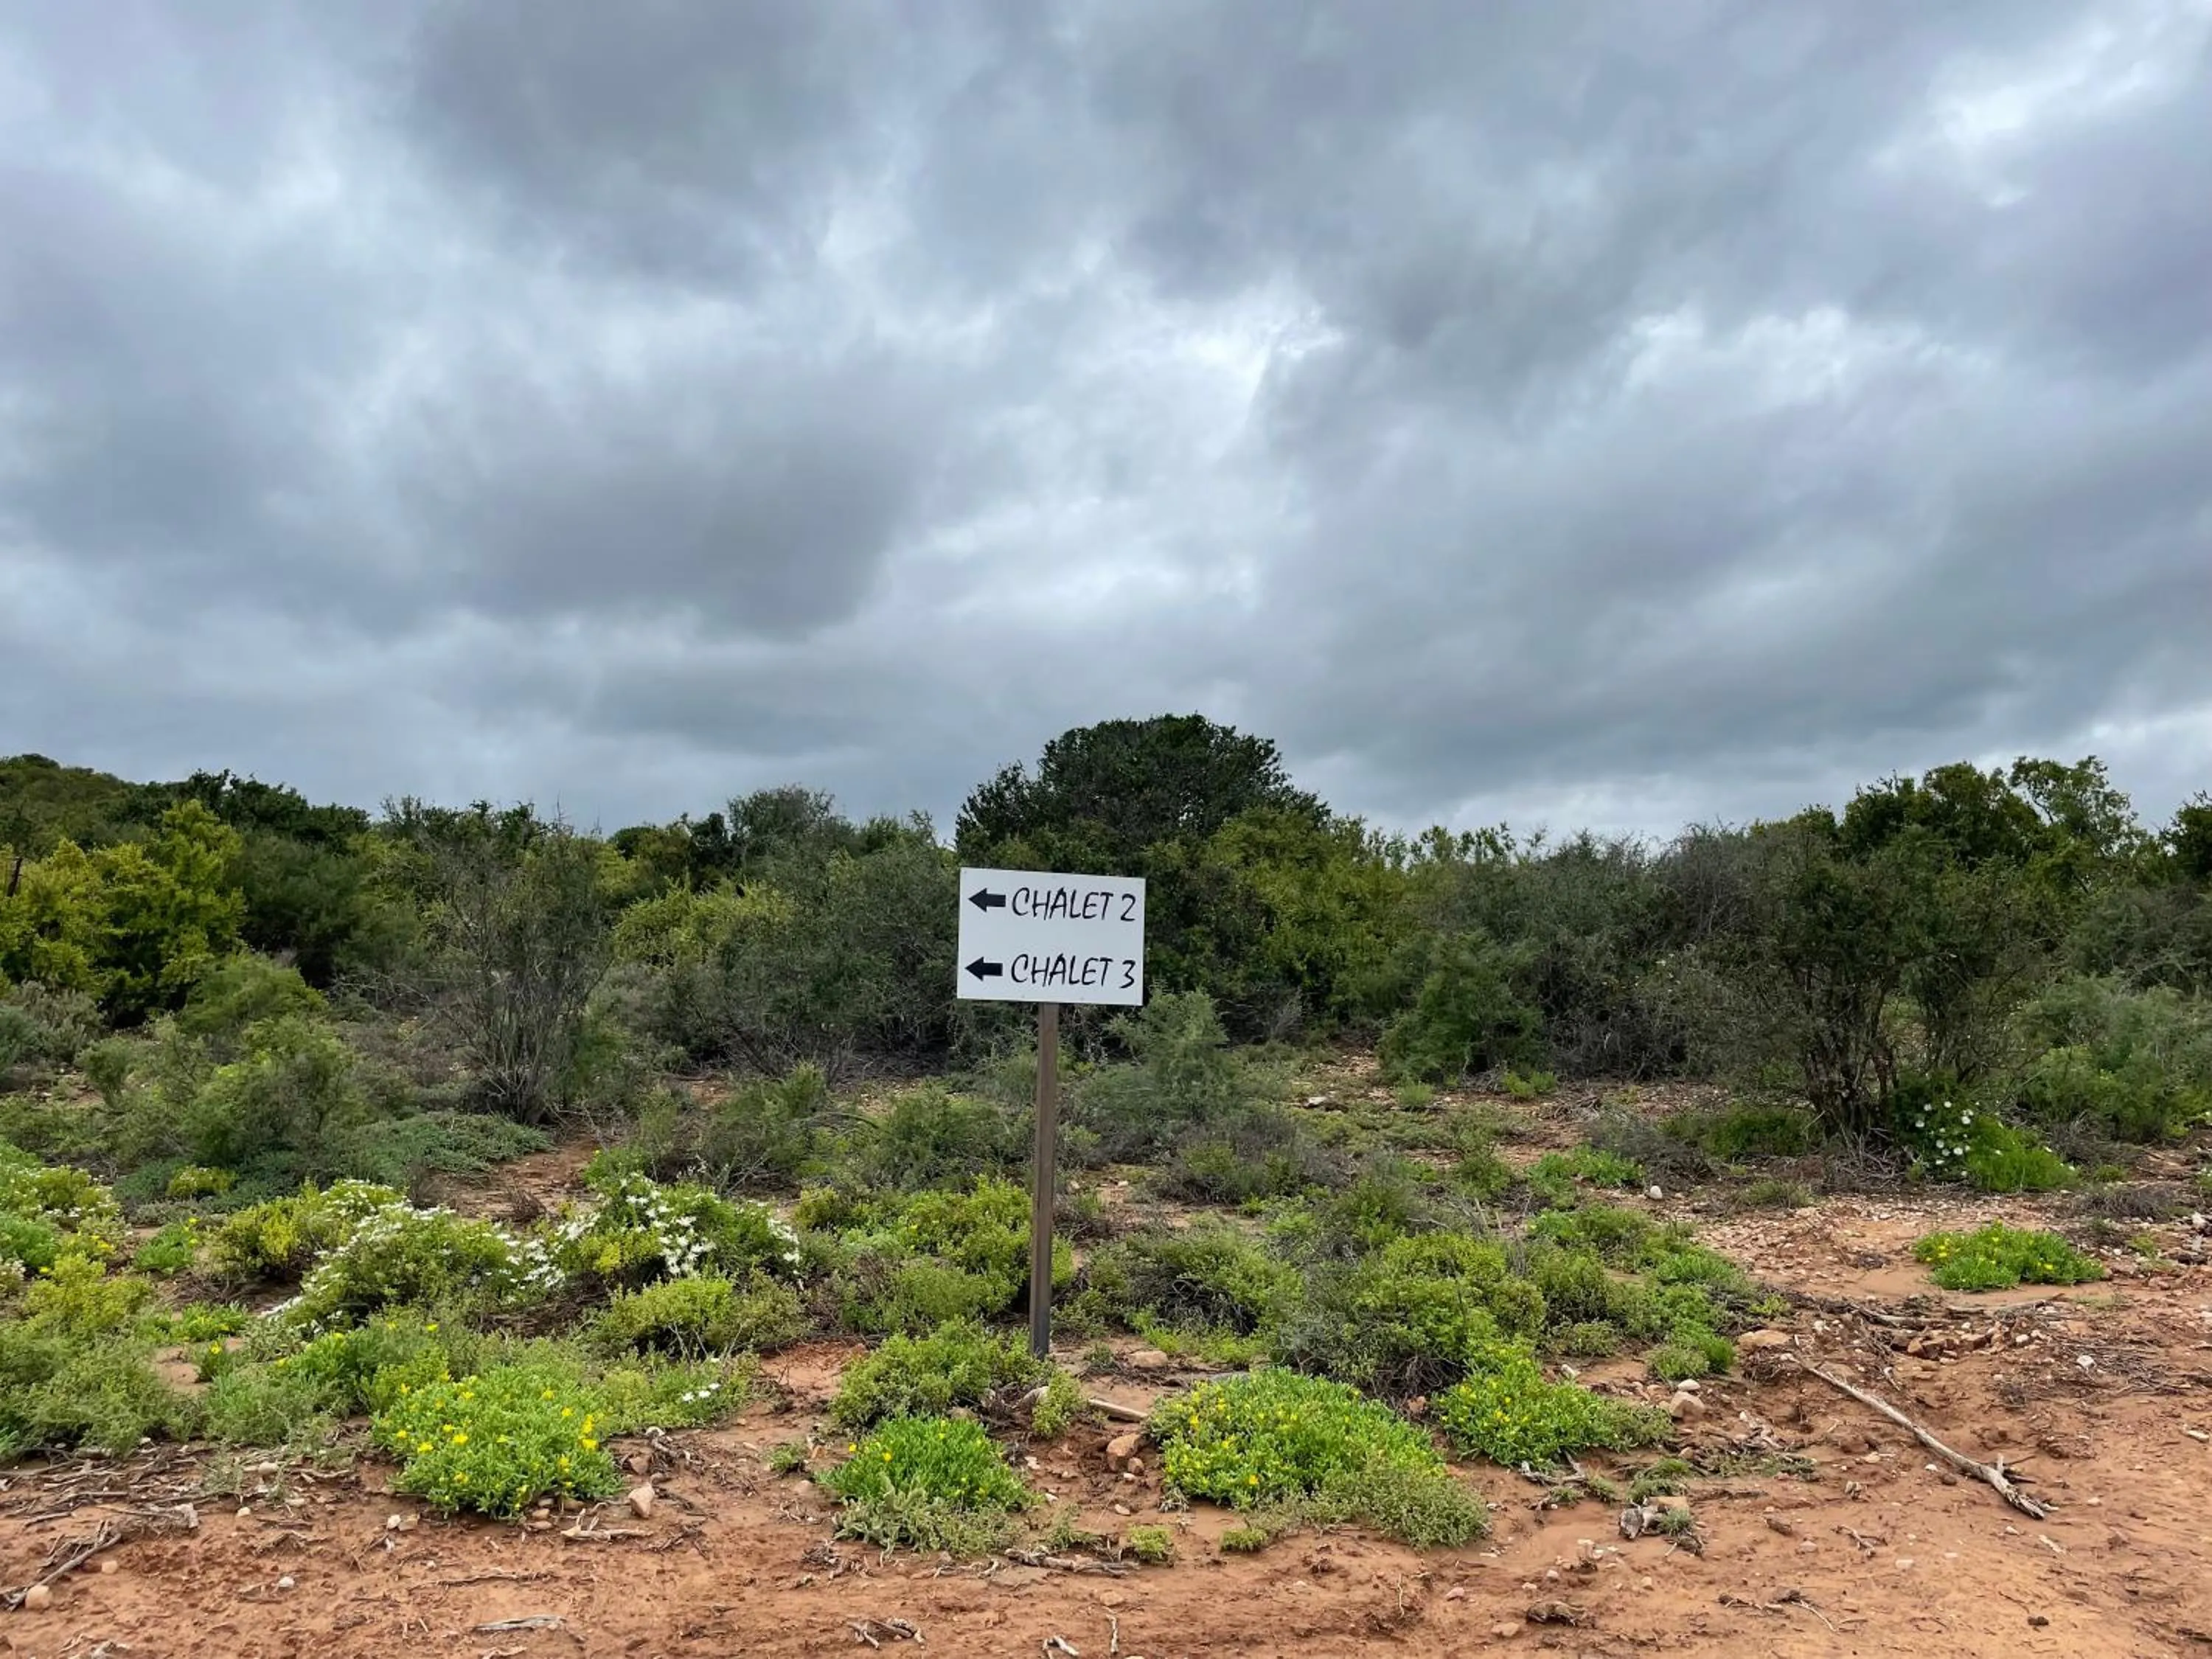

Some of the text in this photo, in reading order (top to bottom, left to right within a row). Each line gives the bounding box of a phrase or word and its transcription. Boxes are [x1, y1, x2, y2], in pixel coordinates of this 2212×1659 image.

[1012, 887, 1136, 922] CHALET 2
[1010, 953, 1136, 989] CHALET 3
